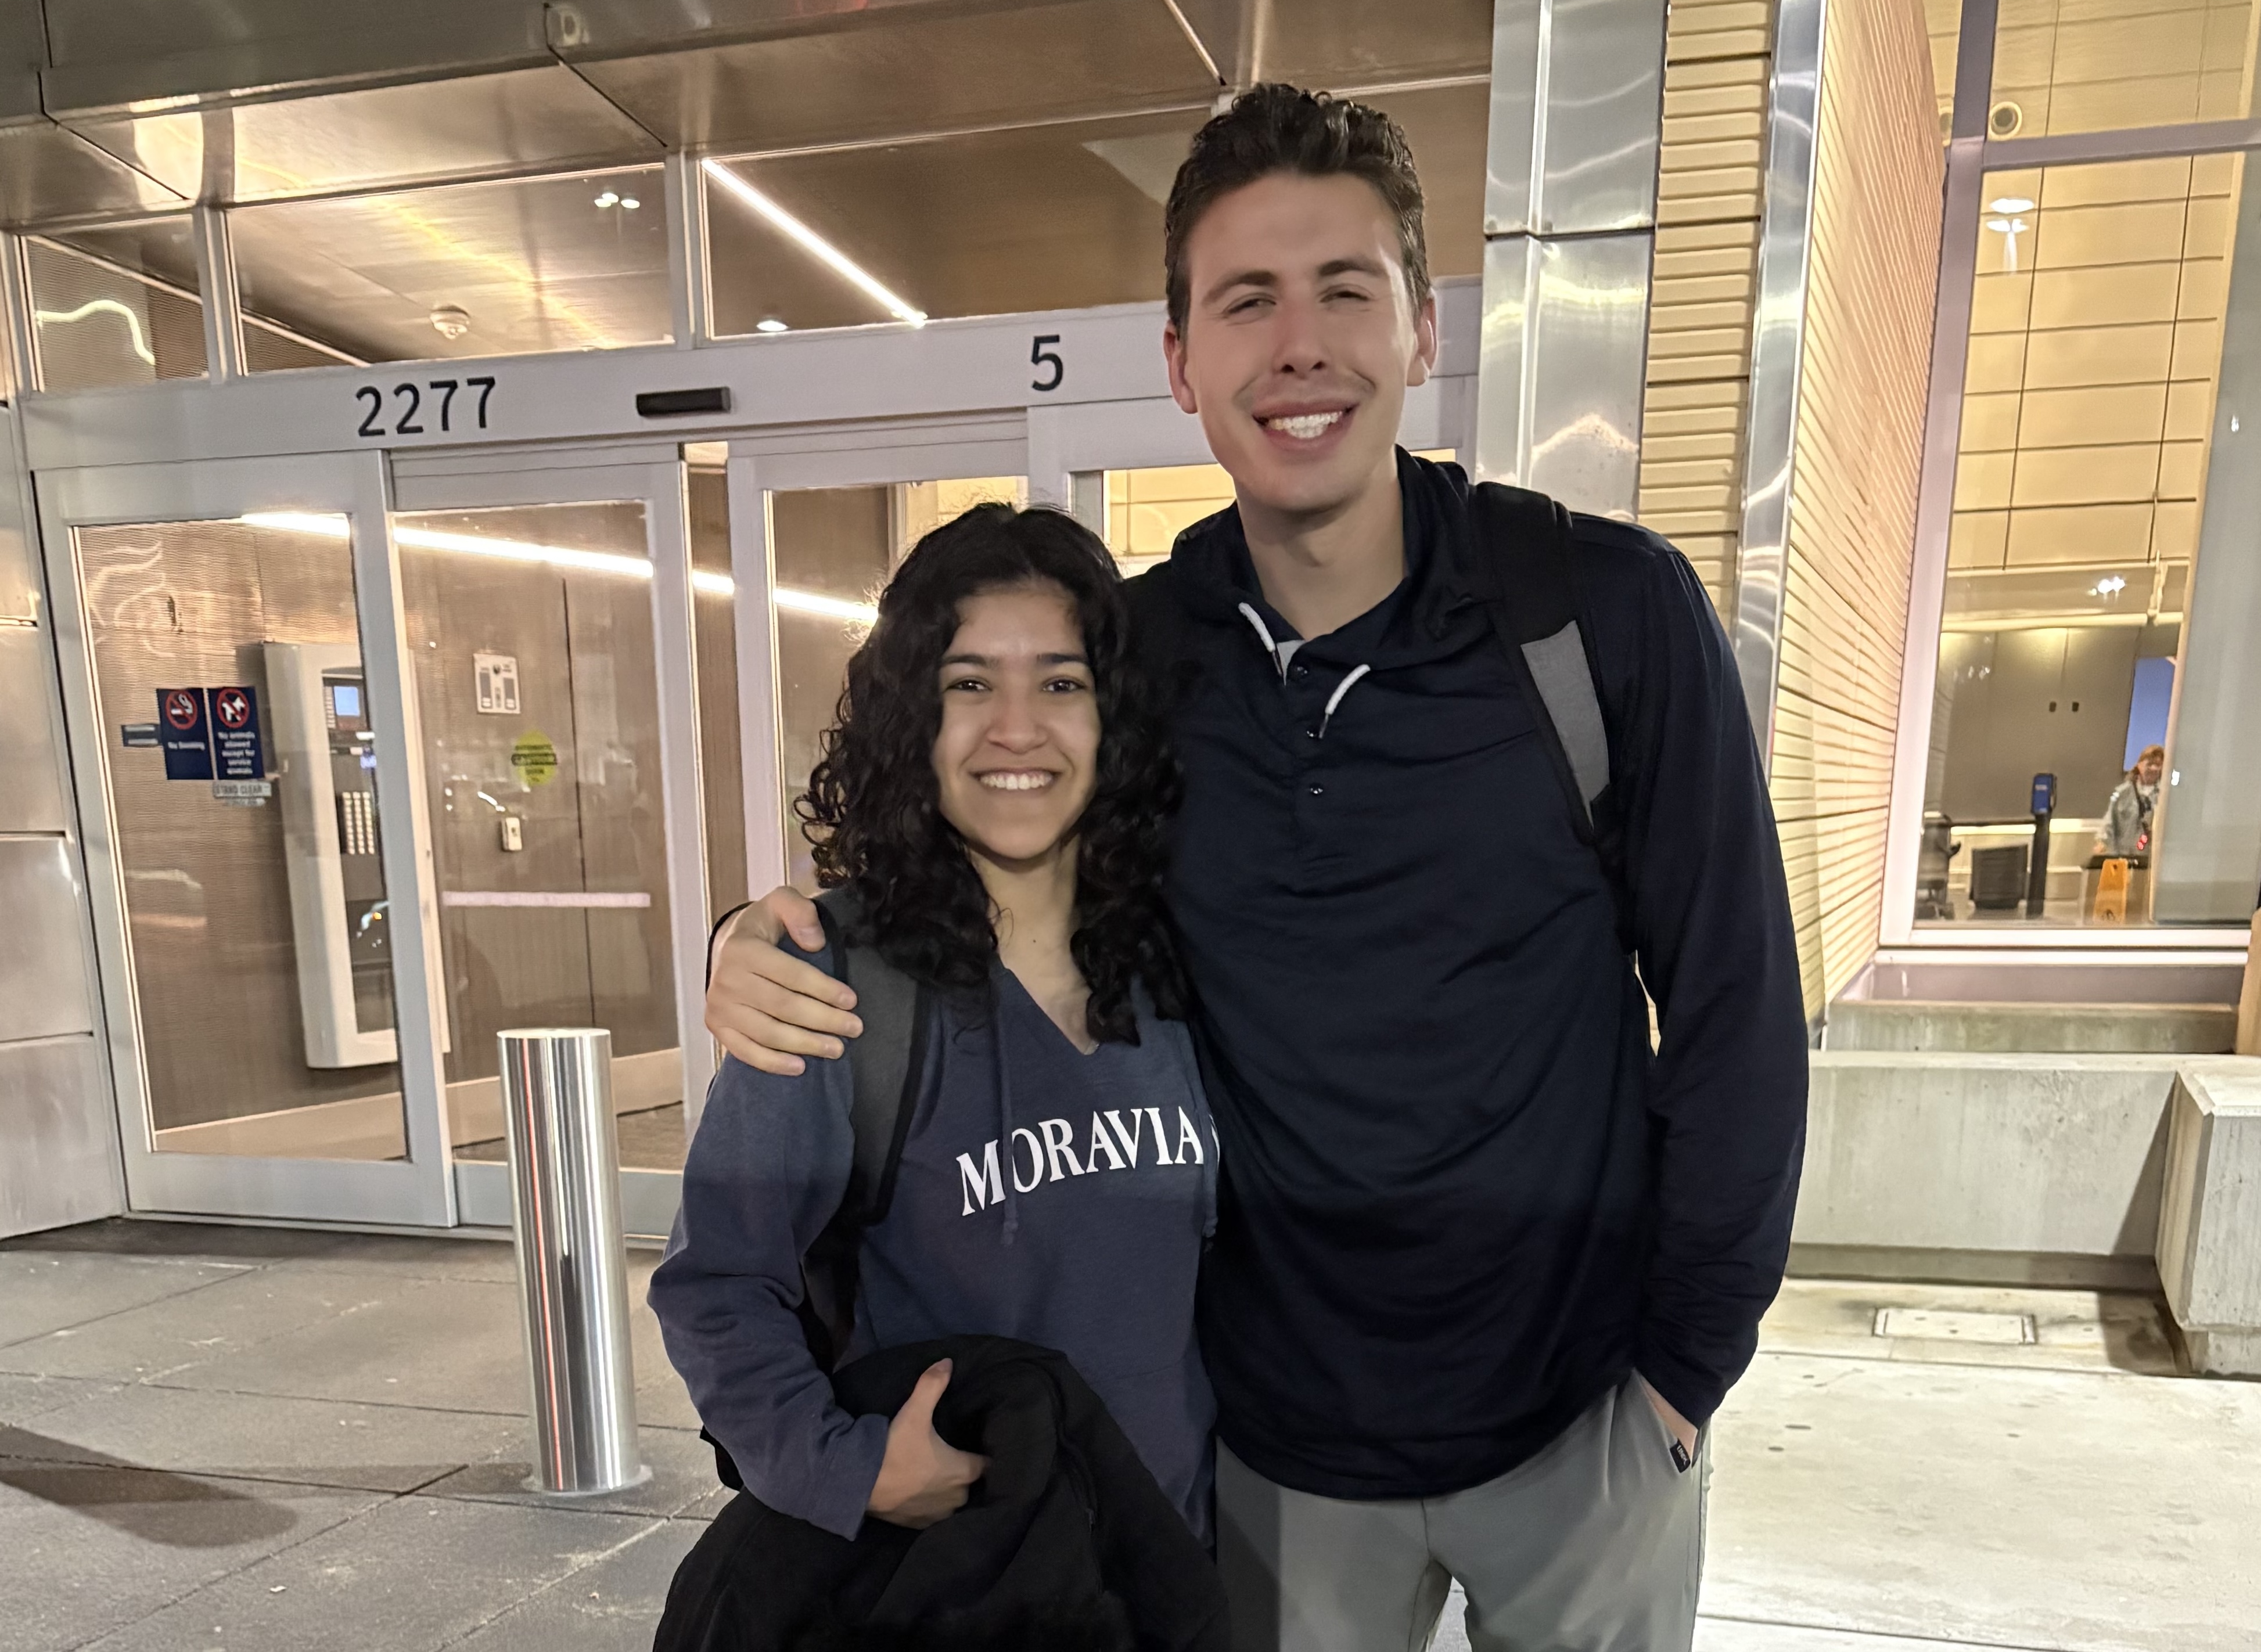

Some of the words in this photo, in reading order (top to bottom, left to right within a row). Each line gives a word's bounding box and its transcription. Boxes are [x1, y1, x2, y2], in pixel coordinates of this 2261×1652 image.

[1031, 334, 1063, 391] 5
[355, 376, 496, 437] 2277
[956, 1106, 1220, 1216] MORAVIA
